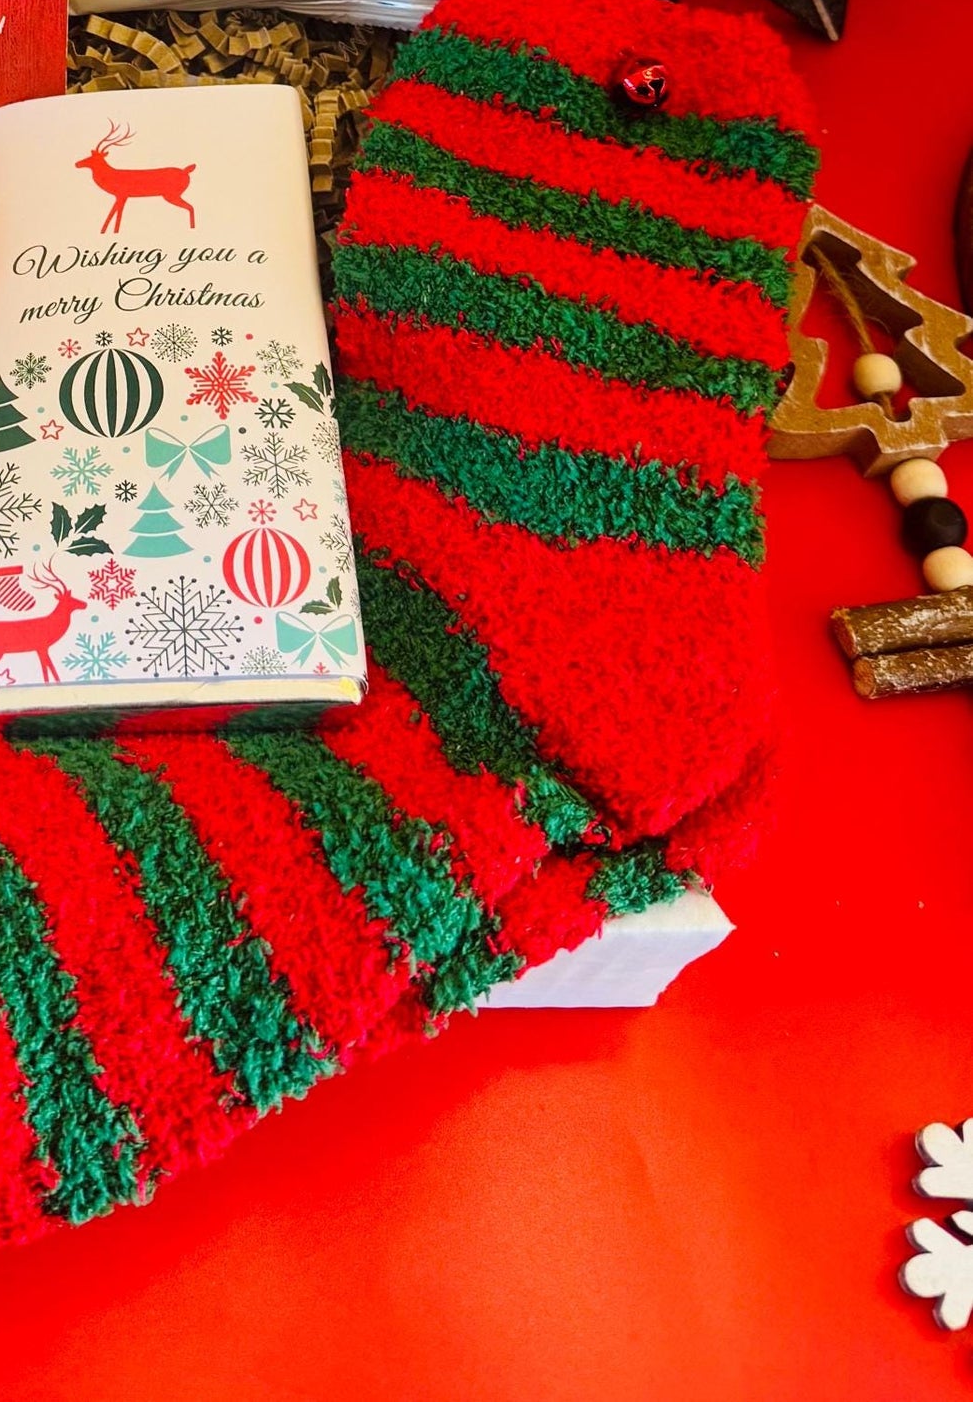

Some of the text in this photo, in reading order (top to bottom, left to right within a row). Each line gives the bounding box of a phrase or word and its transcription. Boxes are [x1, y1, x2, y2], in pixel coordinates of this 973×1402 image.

[12, 241, 269, 280] Wishing you a
[19, 277, 267, 326] merry Christmas
